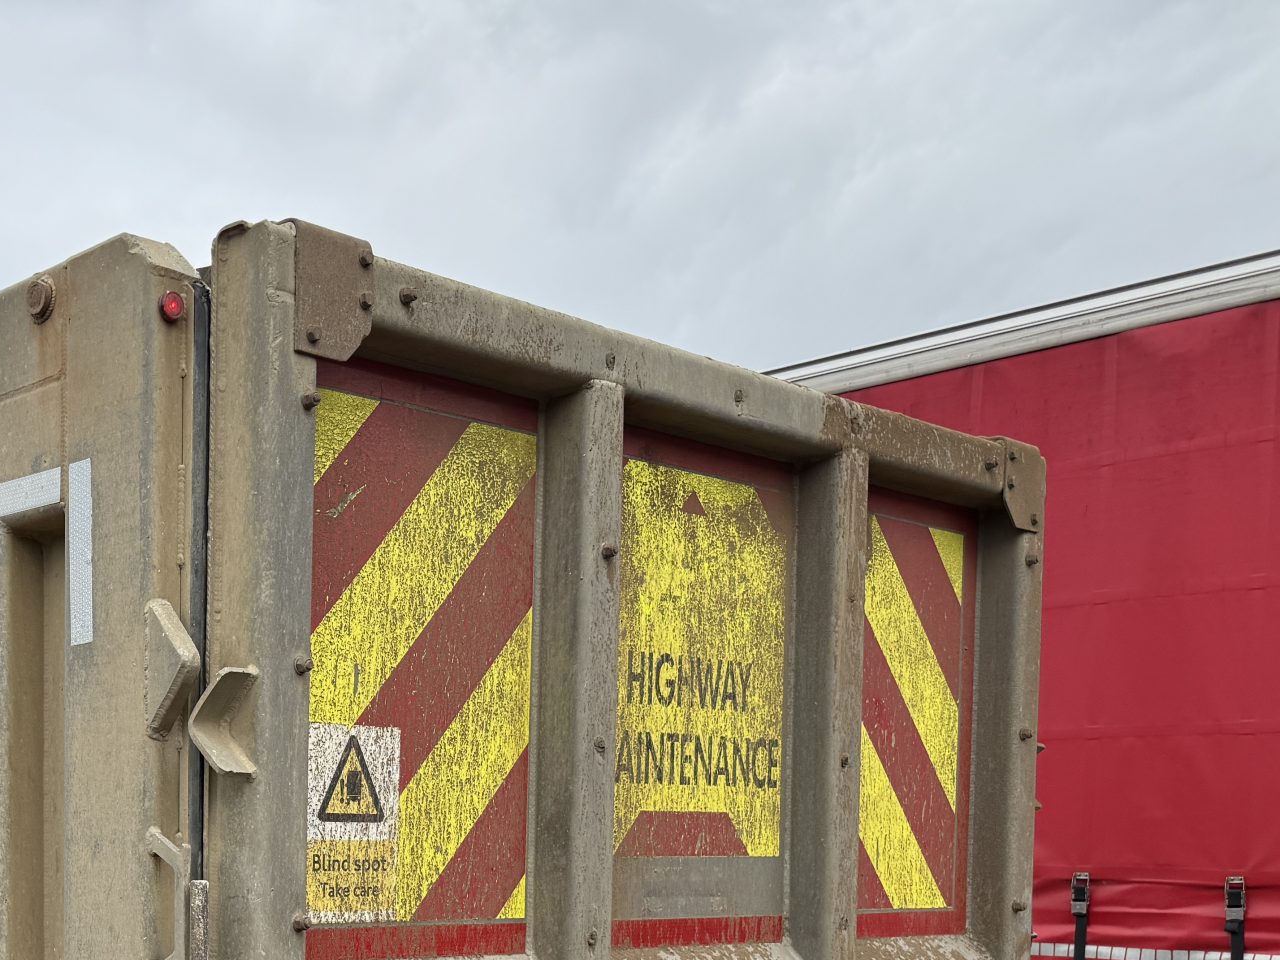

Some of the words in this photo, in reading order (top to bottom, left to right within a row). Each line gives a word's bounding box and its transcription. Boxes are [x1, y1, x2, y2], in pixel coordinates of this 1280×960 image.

[626, 650, 753, 713] HIGHWAY
[614, 729, 779, 789] AINTENANCE
[312, 853, 351, 872] Blind
[353, 855, 387, 879] spot
[320, 882, 350, 898] Take
[353, 885, 381, 898] care
